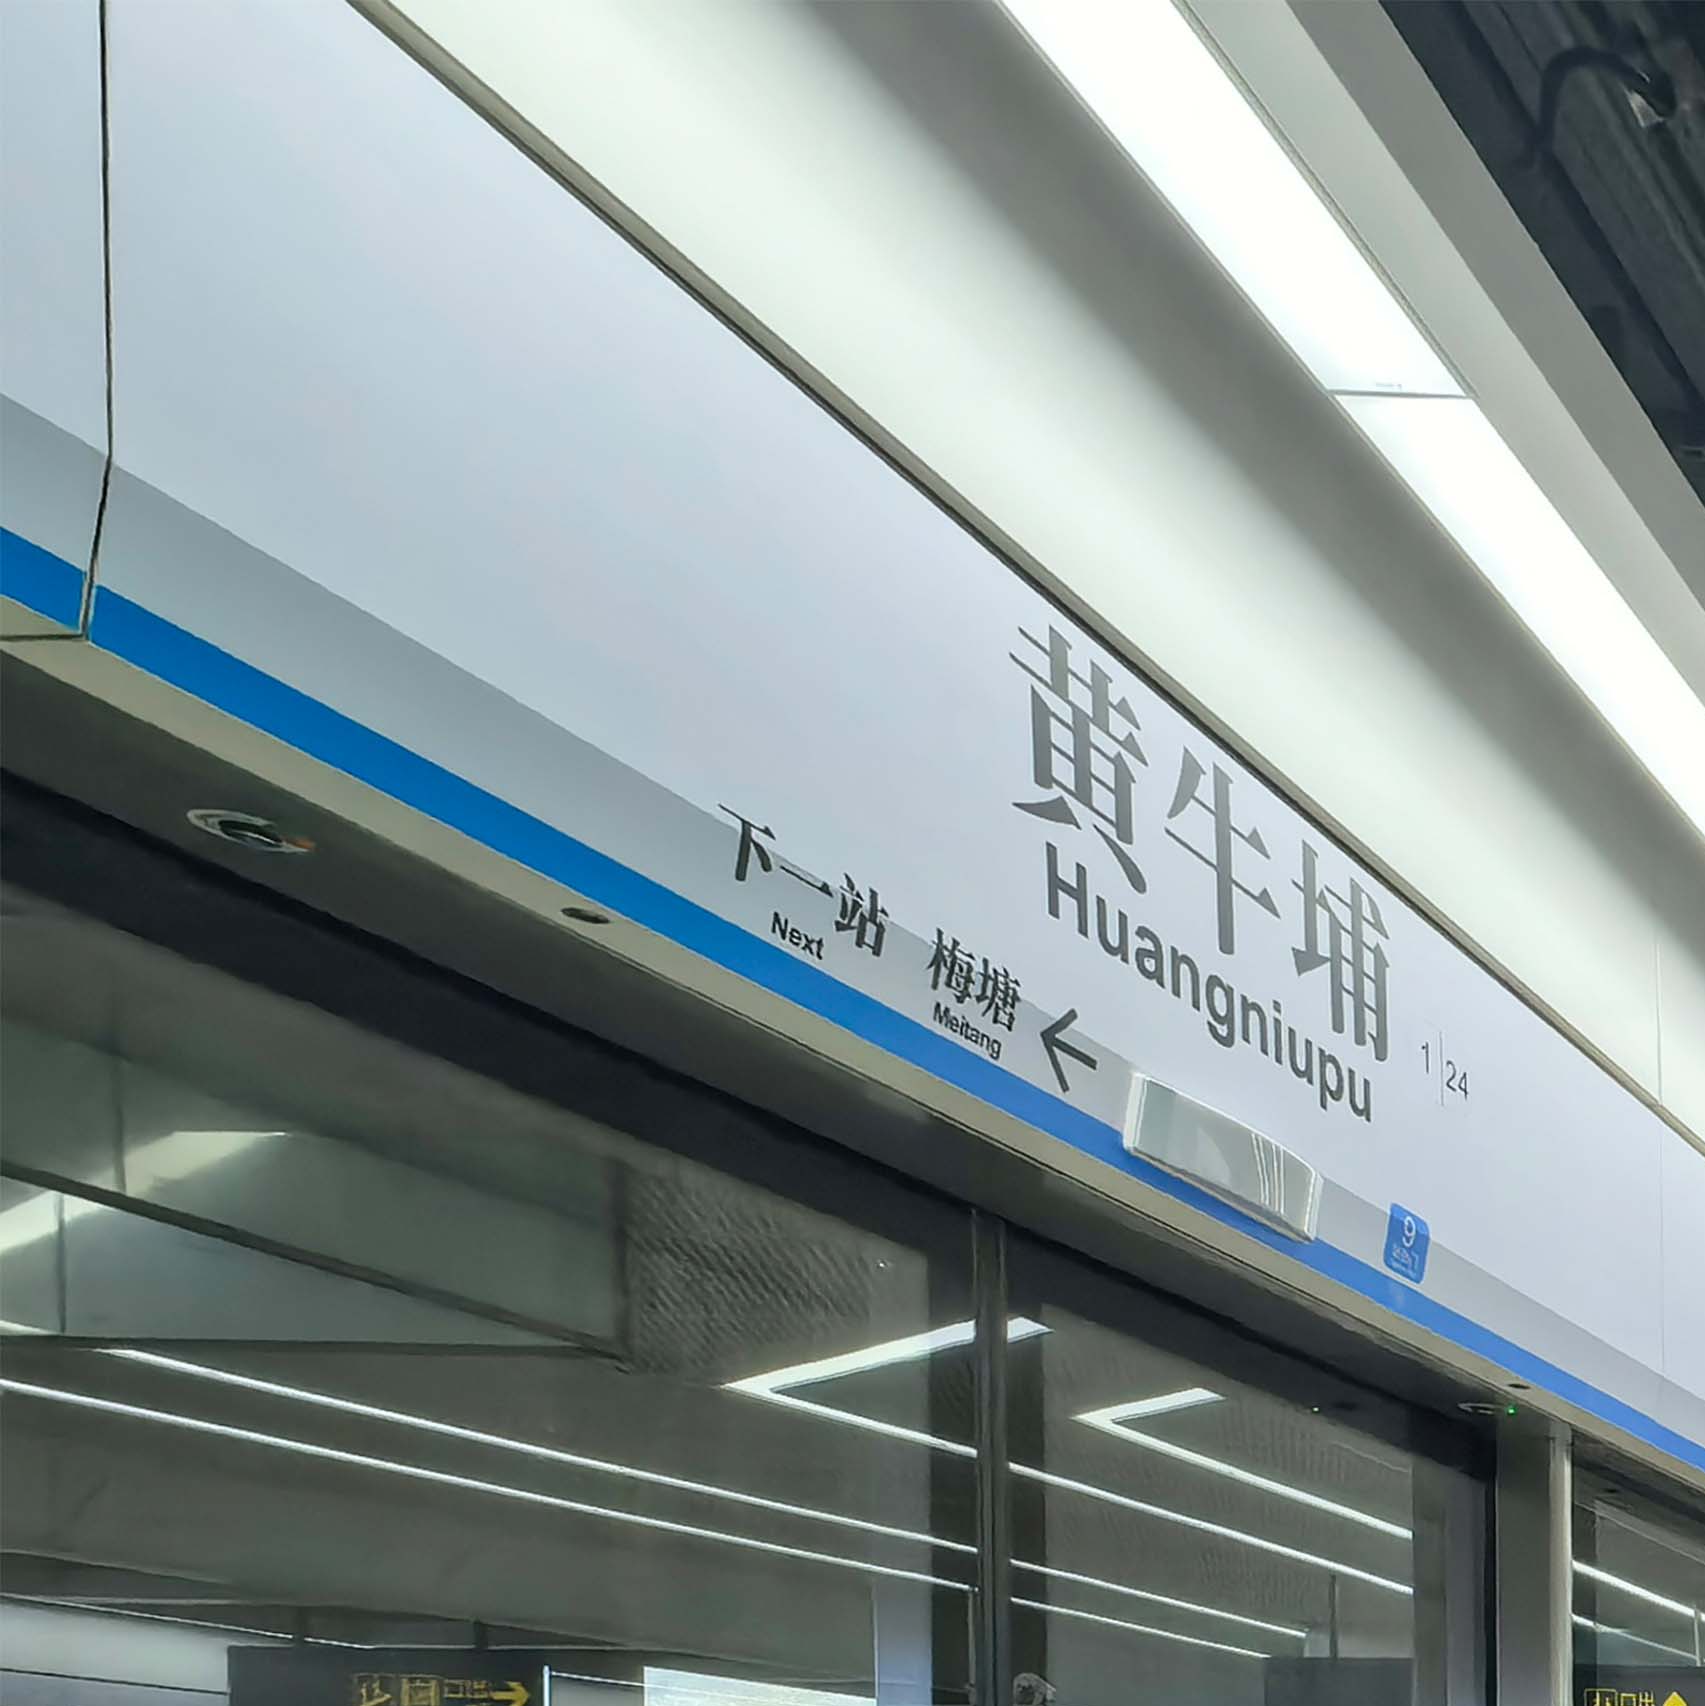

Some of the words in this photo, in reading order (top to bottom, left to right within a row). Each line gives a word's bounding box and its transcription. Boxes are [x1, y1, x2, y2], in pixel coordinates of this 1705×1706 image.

[1008, 623, 1390, 1063] 黄牛埔
[718, 803, 890, 957] 下一站
[927, 927, 1021, 1032] 梅塘
[771, 912, 824, 960] Next
[1044, 841, 1373, 1124] Huangniupu
[932, 1002, 1002, 1061] Meitang
[1445, 1060, 1469, 1101] 24
